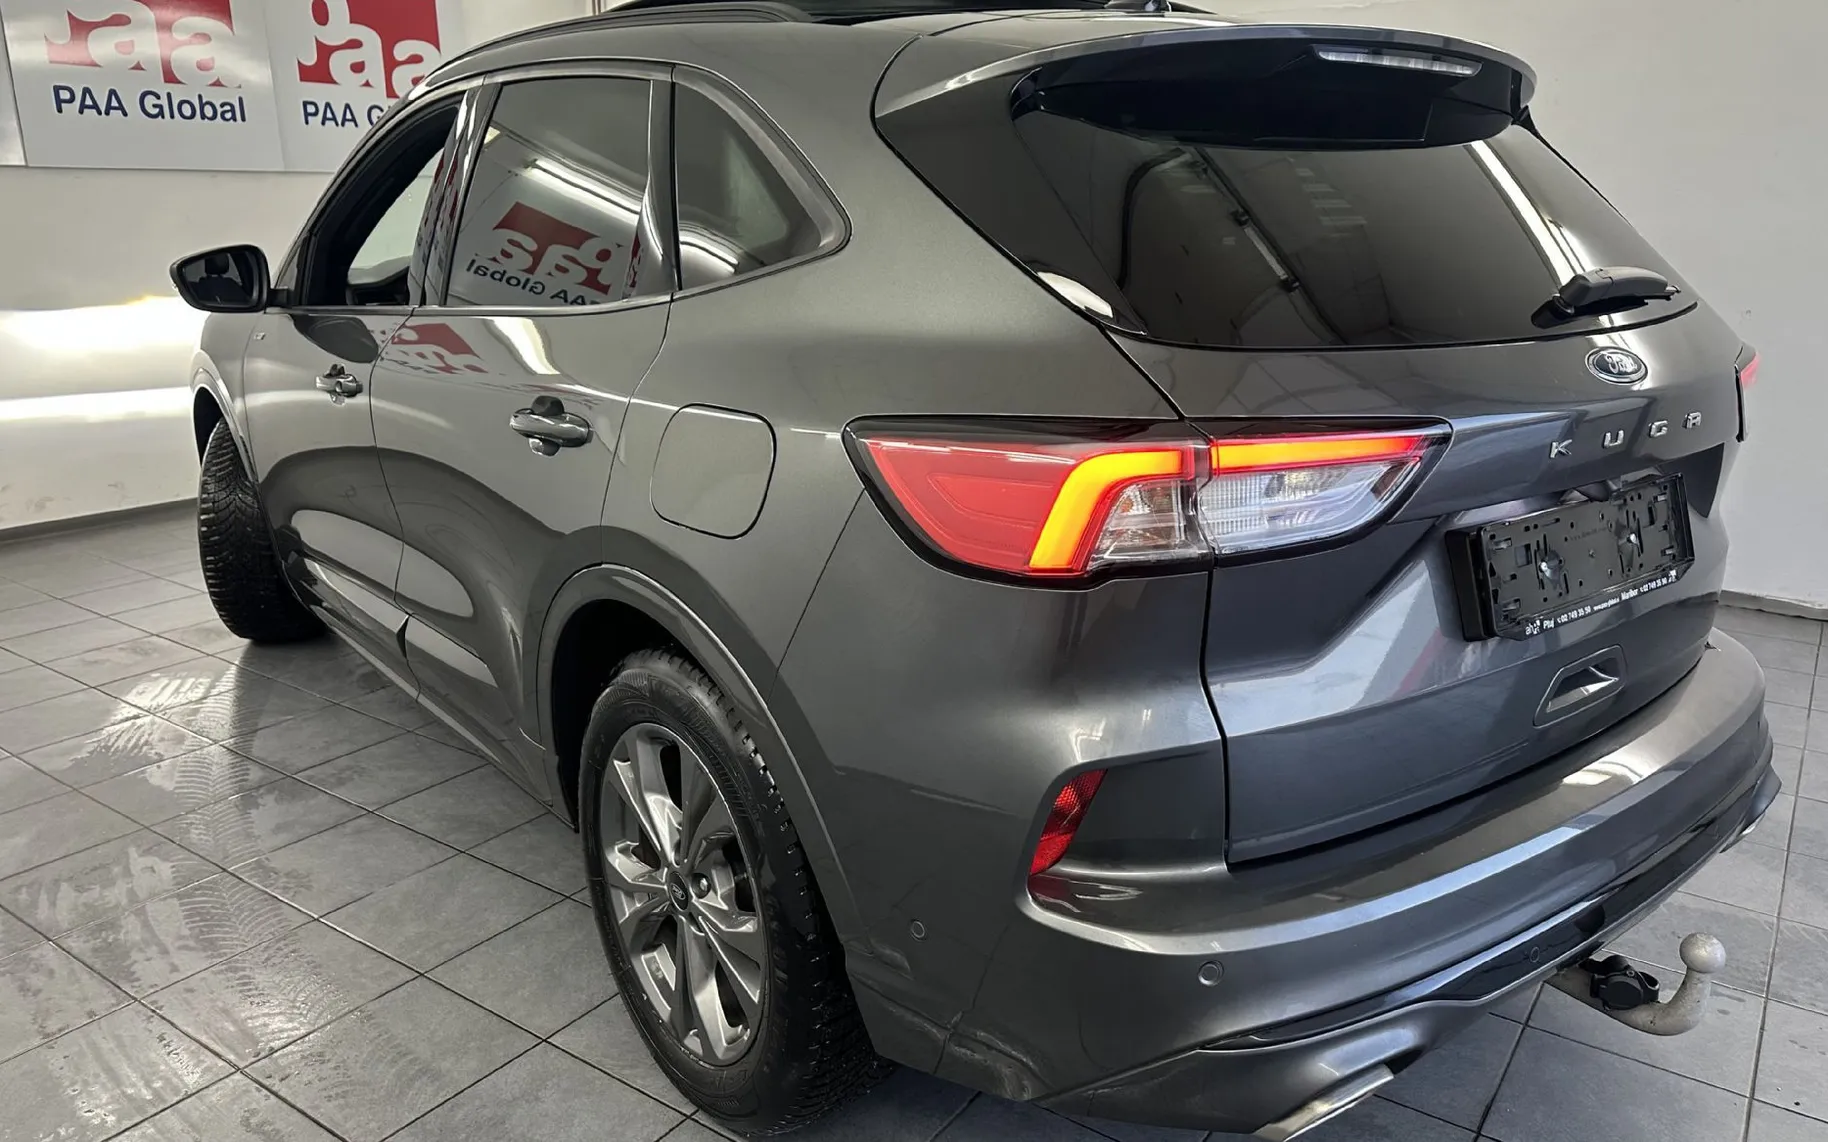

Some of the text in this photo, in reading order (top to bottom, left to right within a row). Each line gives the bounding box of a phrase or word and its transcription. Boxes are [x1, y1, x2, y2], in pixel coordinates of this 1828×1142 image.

[53, 85, 246, 122] PAA Global
[302, 100, 358, 128] PAA
[1550, 411, 1701, 459] KUGA
